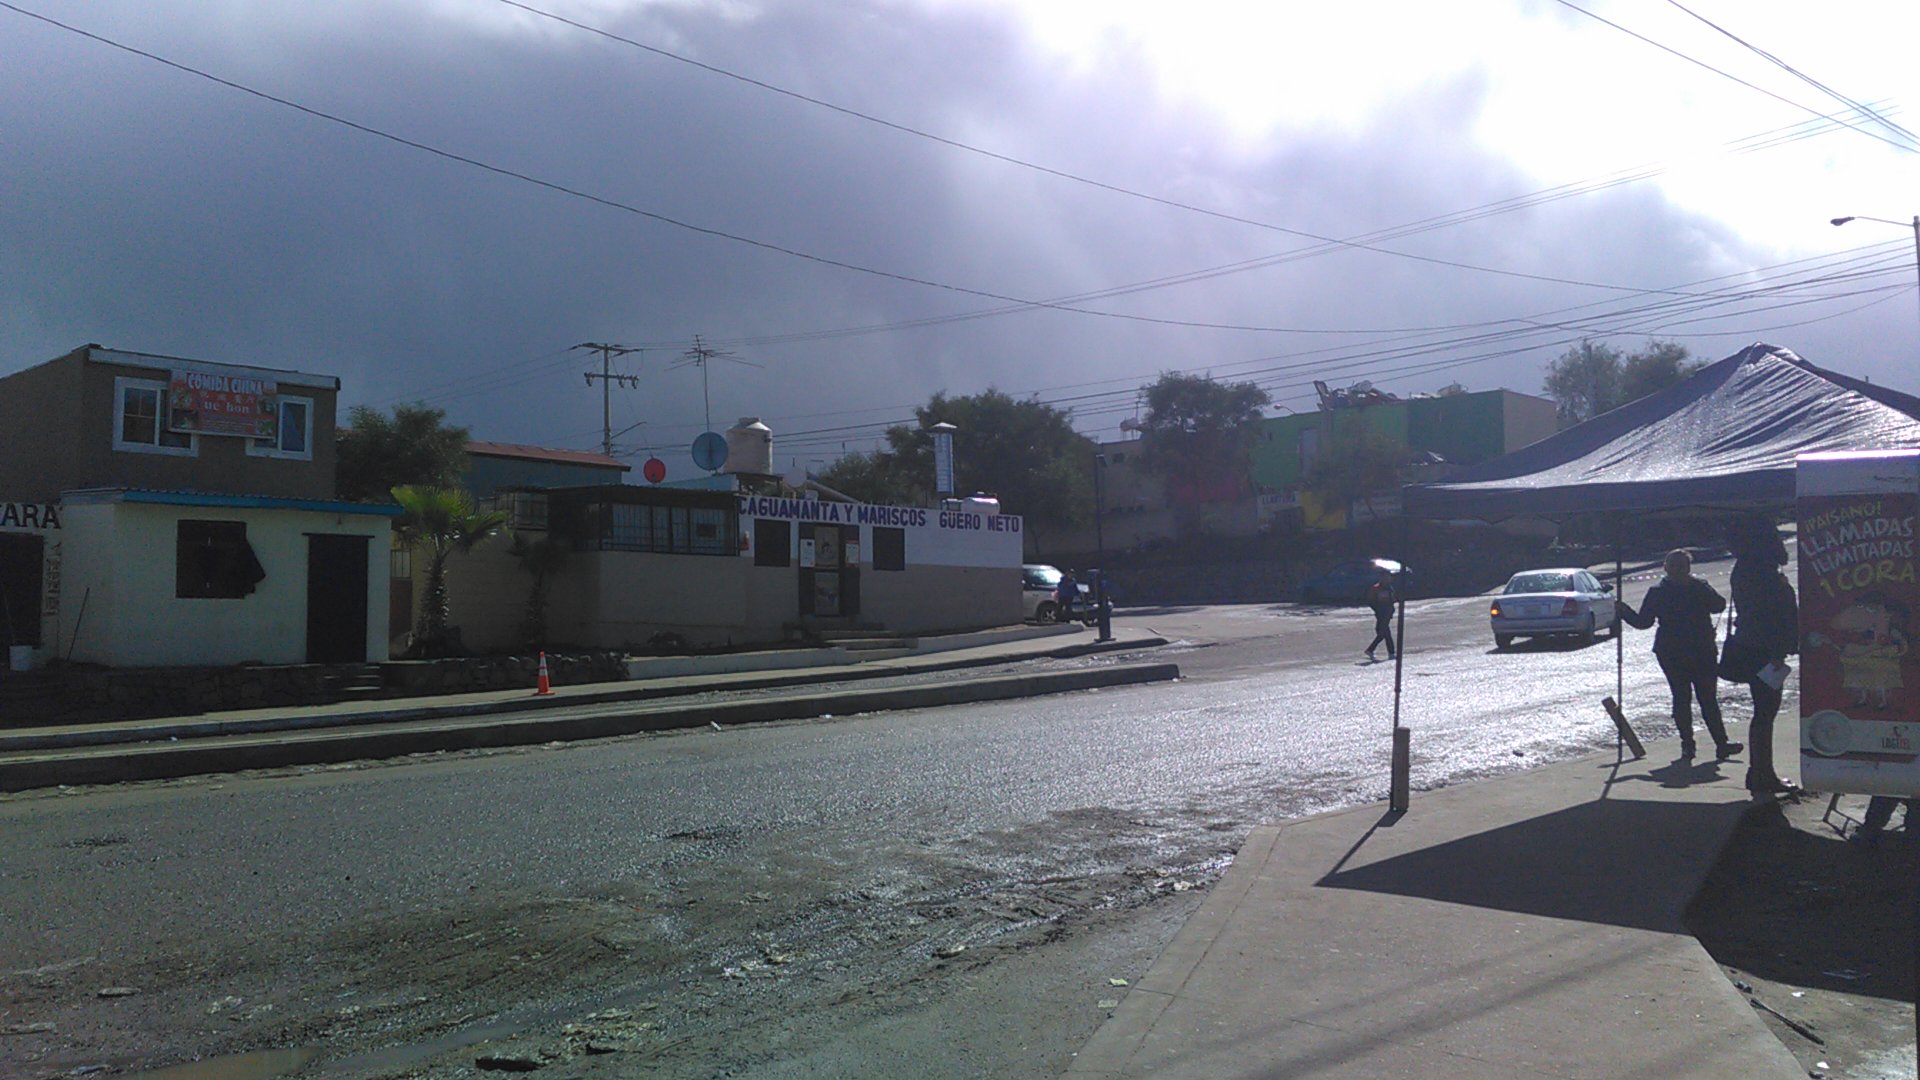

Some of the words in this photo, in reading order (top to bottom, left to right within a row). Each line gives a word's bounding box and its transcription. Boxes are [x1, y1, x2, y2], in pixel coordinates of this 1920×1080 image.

[187, 373, 229, 393] COMIDA
[231, 379, 263, 396] CHINA
[739, 497, 839, 522] CAGUAMANTA
[844, 504, 855, 525] Y
[858, 505, 926, 527] MARISCOS
[939, 511, 981, 530] GÜERO
[987, 514, 1019, 532] NETO
[1800, 517, 1914, 557] LLAMADAS
[1811, 540, 1914, 577] ILIMITADAS
